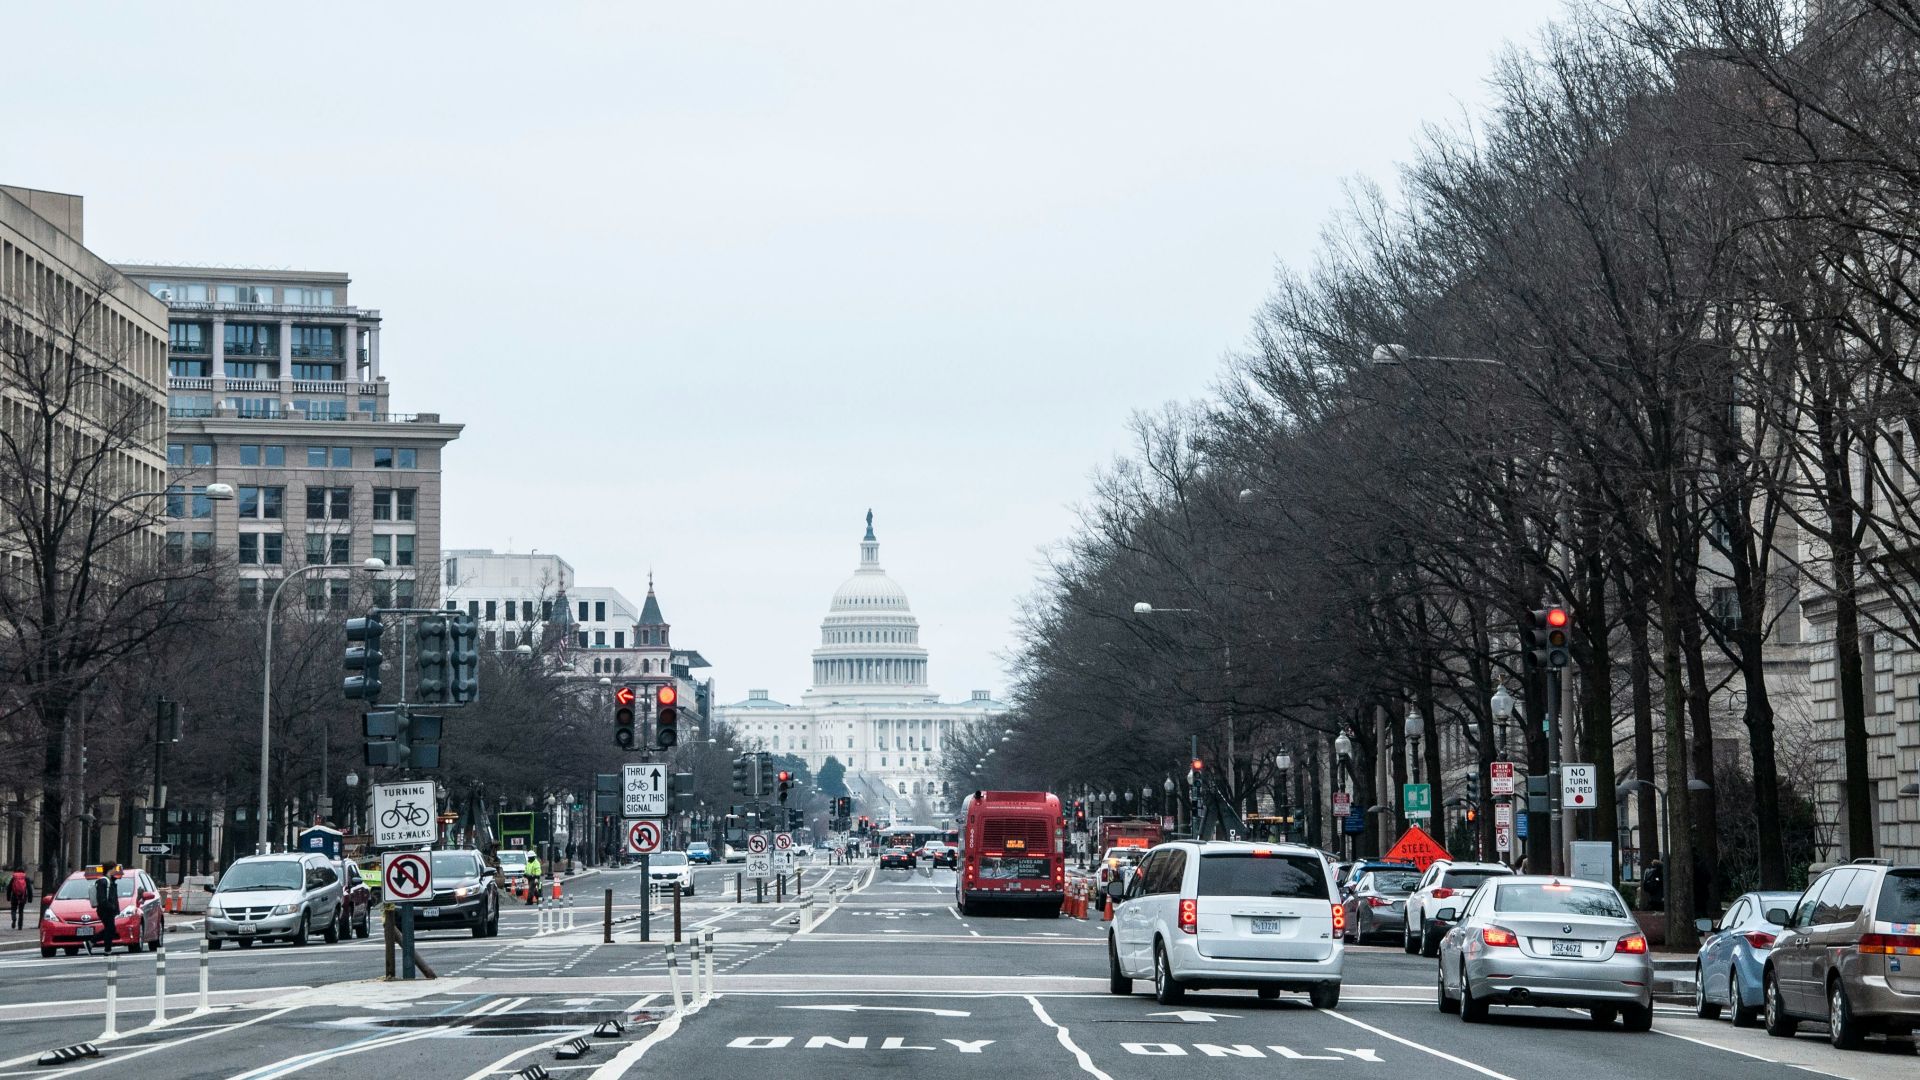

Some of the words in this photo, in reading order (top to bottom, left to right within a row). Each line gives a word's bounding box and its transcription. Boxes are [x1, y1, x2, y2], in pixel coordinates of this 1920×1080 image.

[626, 767, 646, 776] THRU
[1571, 768, 1585, 776] NO
[384, 787, 425, 797] TURNING
[1565, 786, 1575, 794] ON
[1578, 786, 1593, 794] RED
[626, 794, 646, 803] OBEY
[649, 793, 665, 802] THIS
[626, 804, 652, 813] SIGNAL
[381, 832, 395, 841] USE
[398, 830, 431, 840] X-WALKS
[1401, 843, 1431, 854] STEEL
[726, 1036, 997, 1053] ONLY
[1120, 1042, 1386, 1062] ONLY
